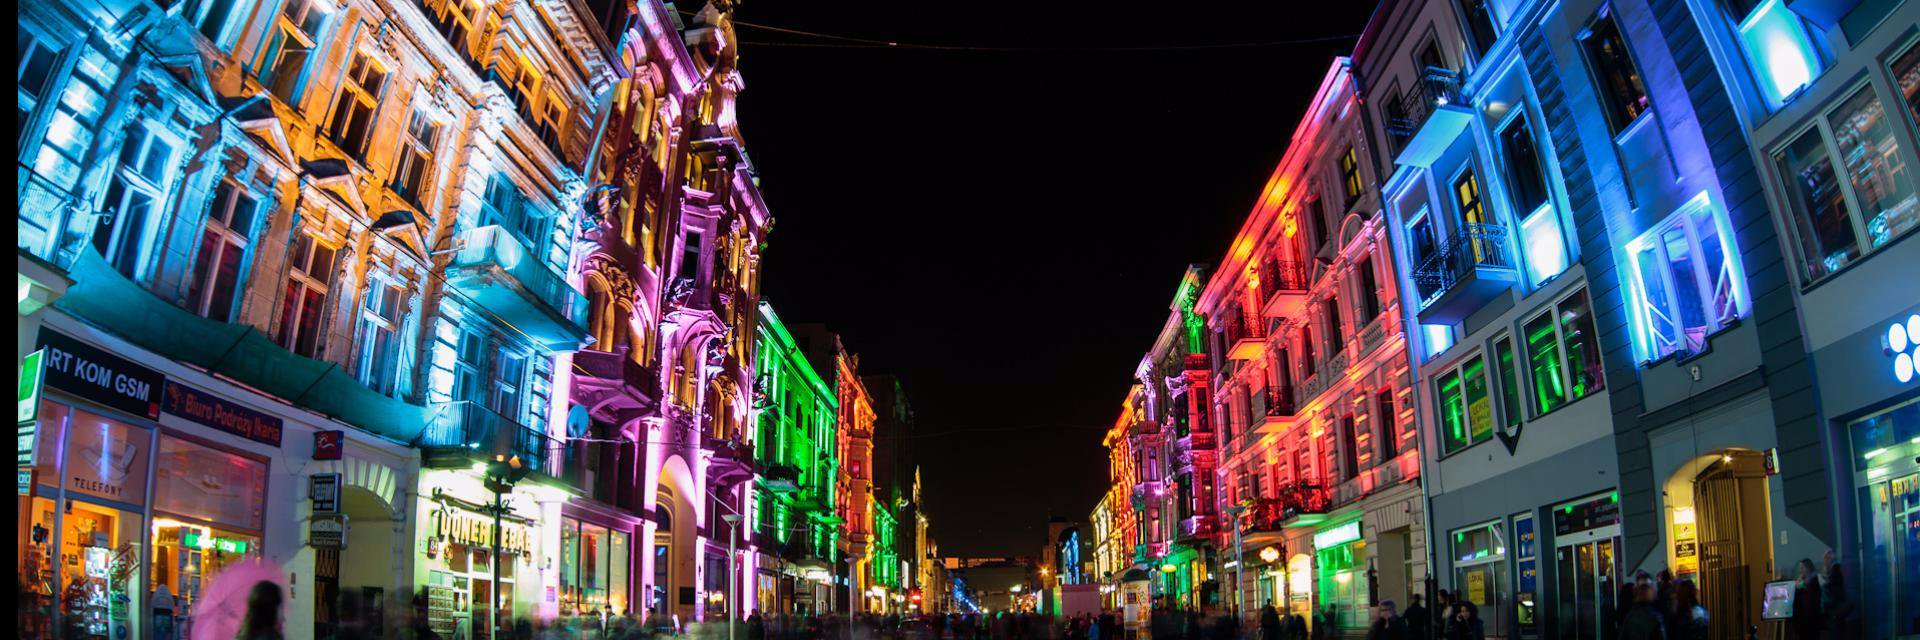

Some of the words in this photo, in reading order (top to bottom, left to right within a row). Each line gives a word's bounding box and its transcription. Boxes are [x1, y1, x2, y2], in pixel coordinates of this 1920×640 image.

[74, 357, 112, 388] KOM
[115, 373, 150, 402] GSM
[186, 393, 212, 419] Biuro
[74, 477, 122, 496] TELEFONY
[430, 540, 439, 551] 84
[492, 523, 533, 551] EBAB
